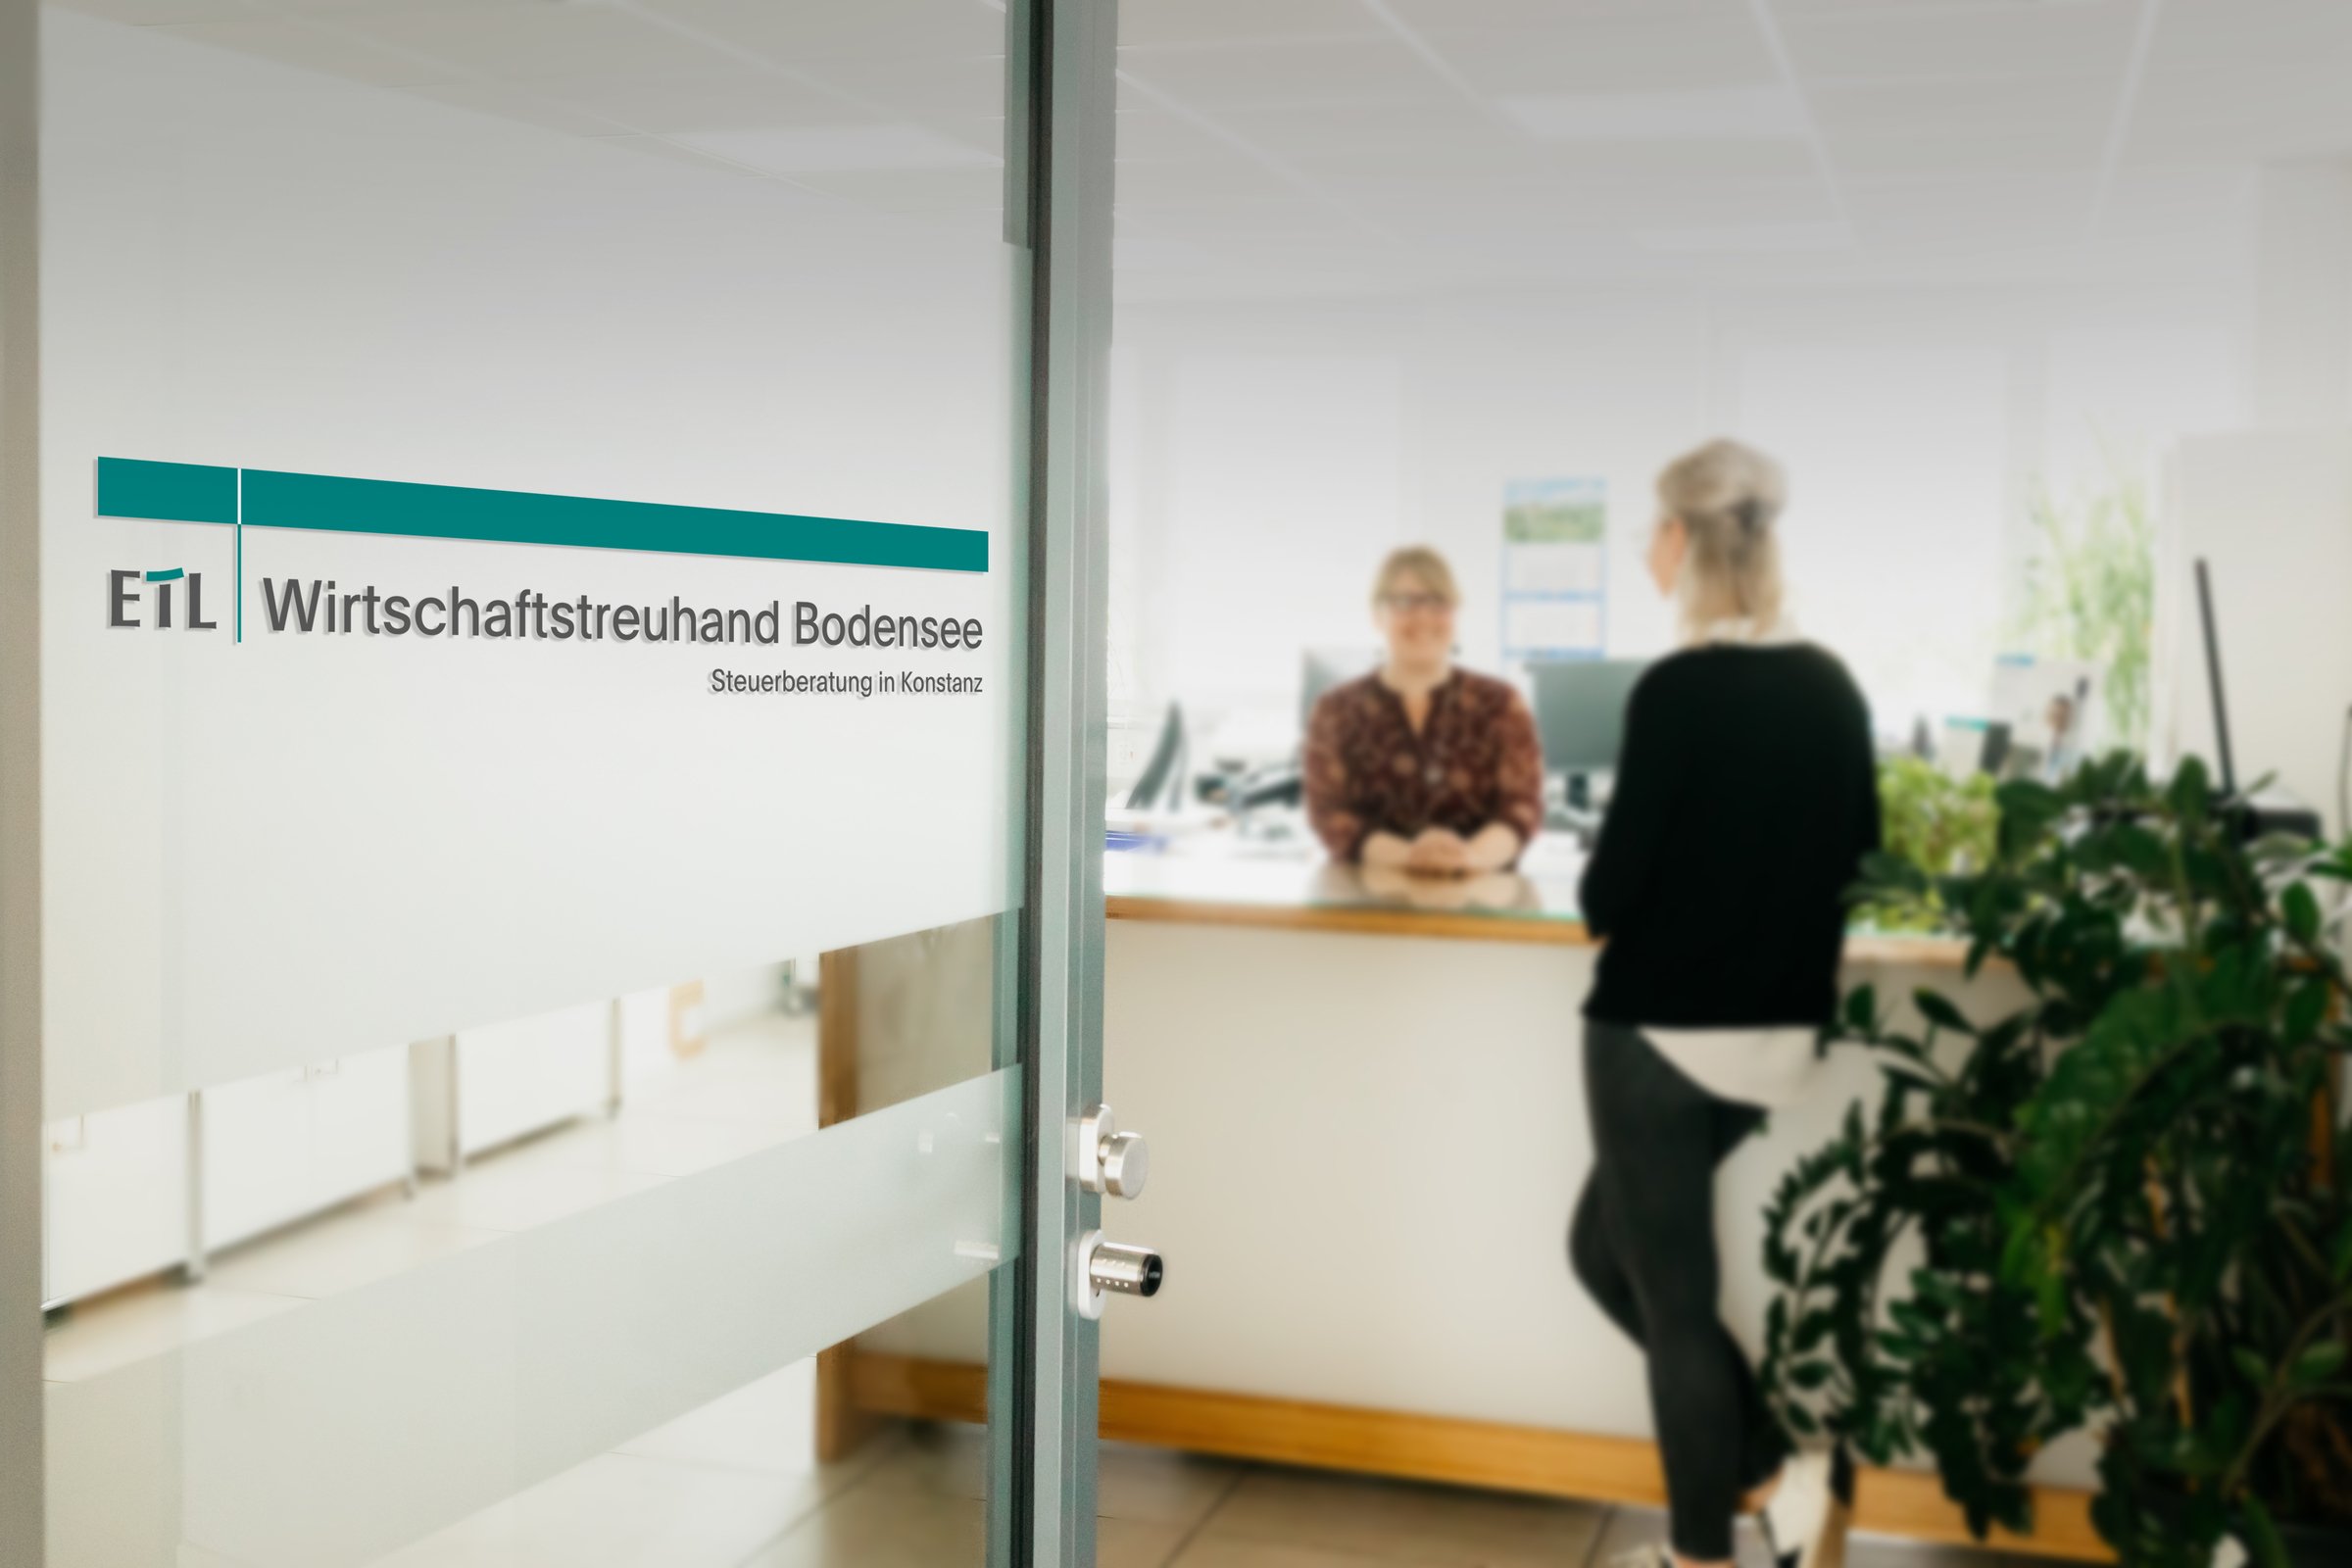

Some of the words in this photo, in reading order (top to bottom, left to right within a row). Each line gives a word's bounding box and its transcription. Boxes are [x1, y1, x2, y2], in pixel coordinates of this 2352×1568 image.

[110, 566, 218, 629] ETL
[263, 576, 779, 644] Wirtschaftstreuhand
[795, 601, 984, 650] Bodensee
[711, 668, 873, 698] Steuerberatung
[879, 670, 895, 693] in
[901, 670, 984, 693] Konstanz
